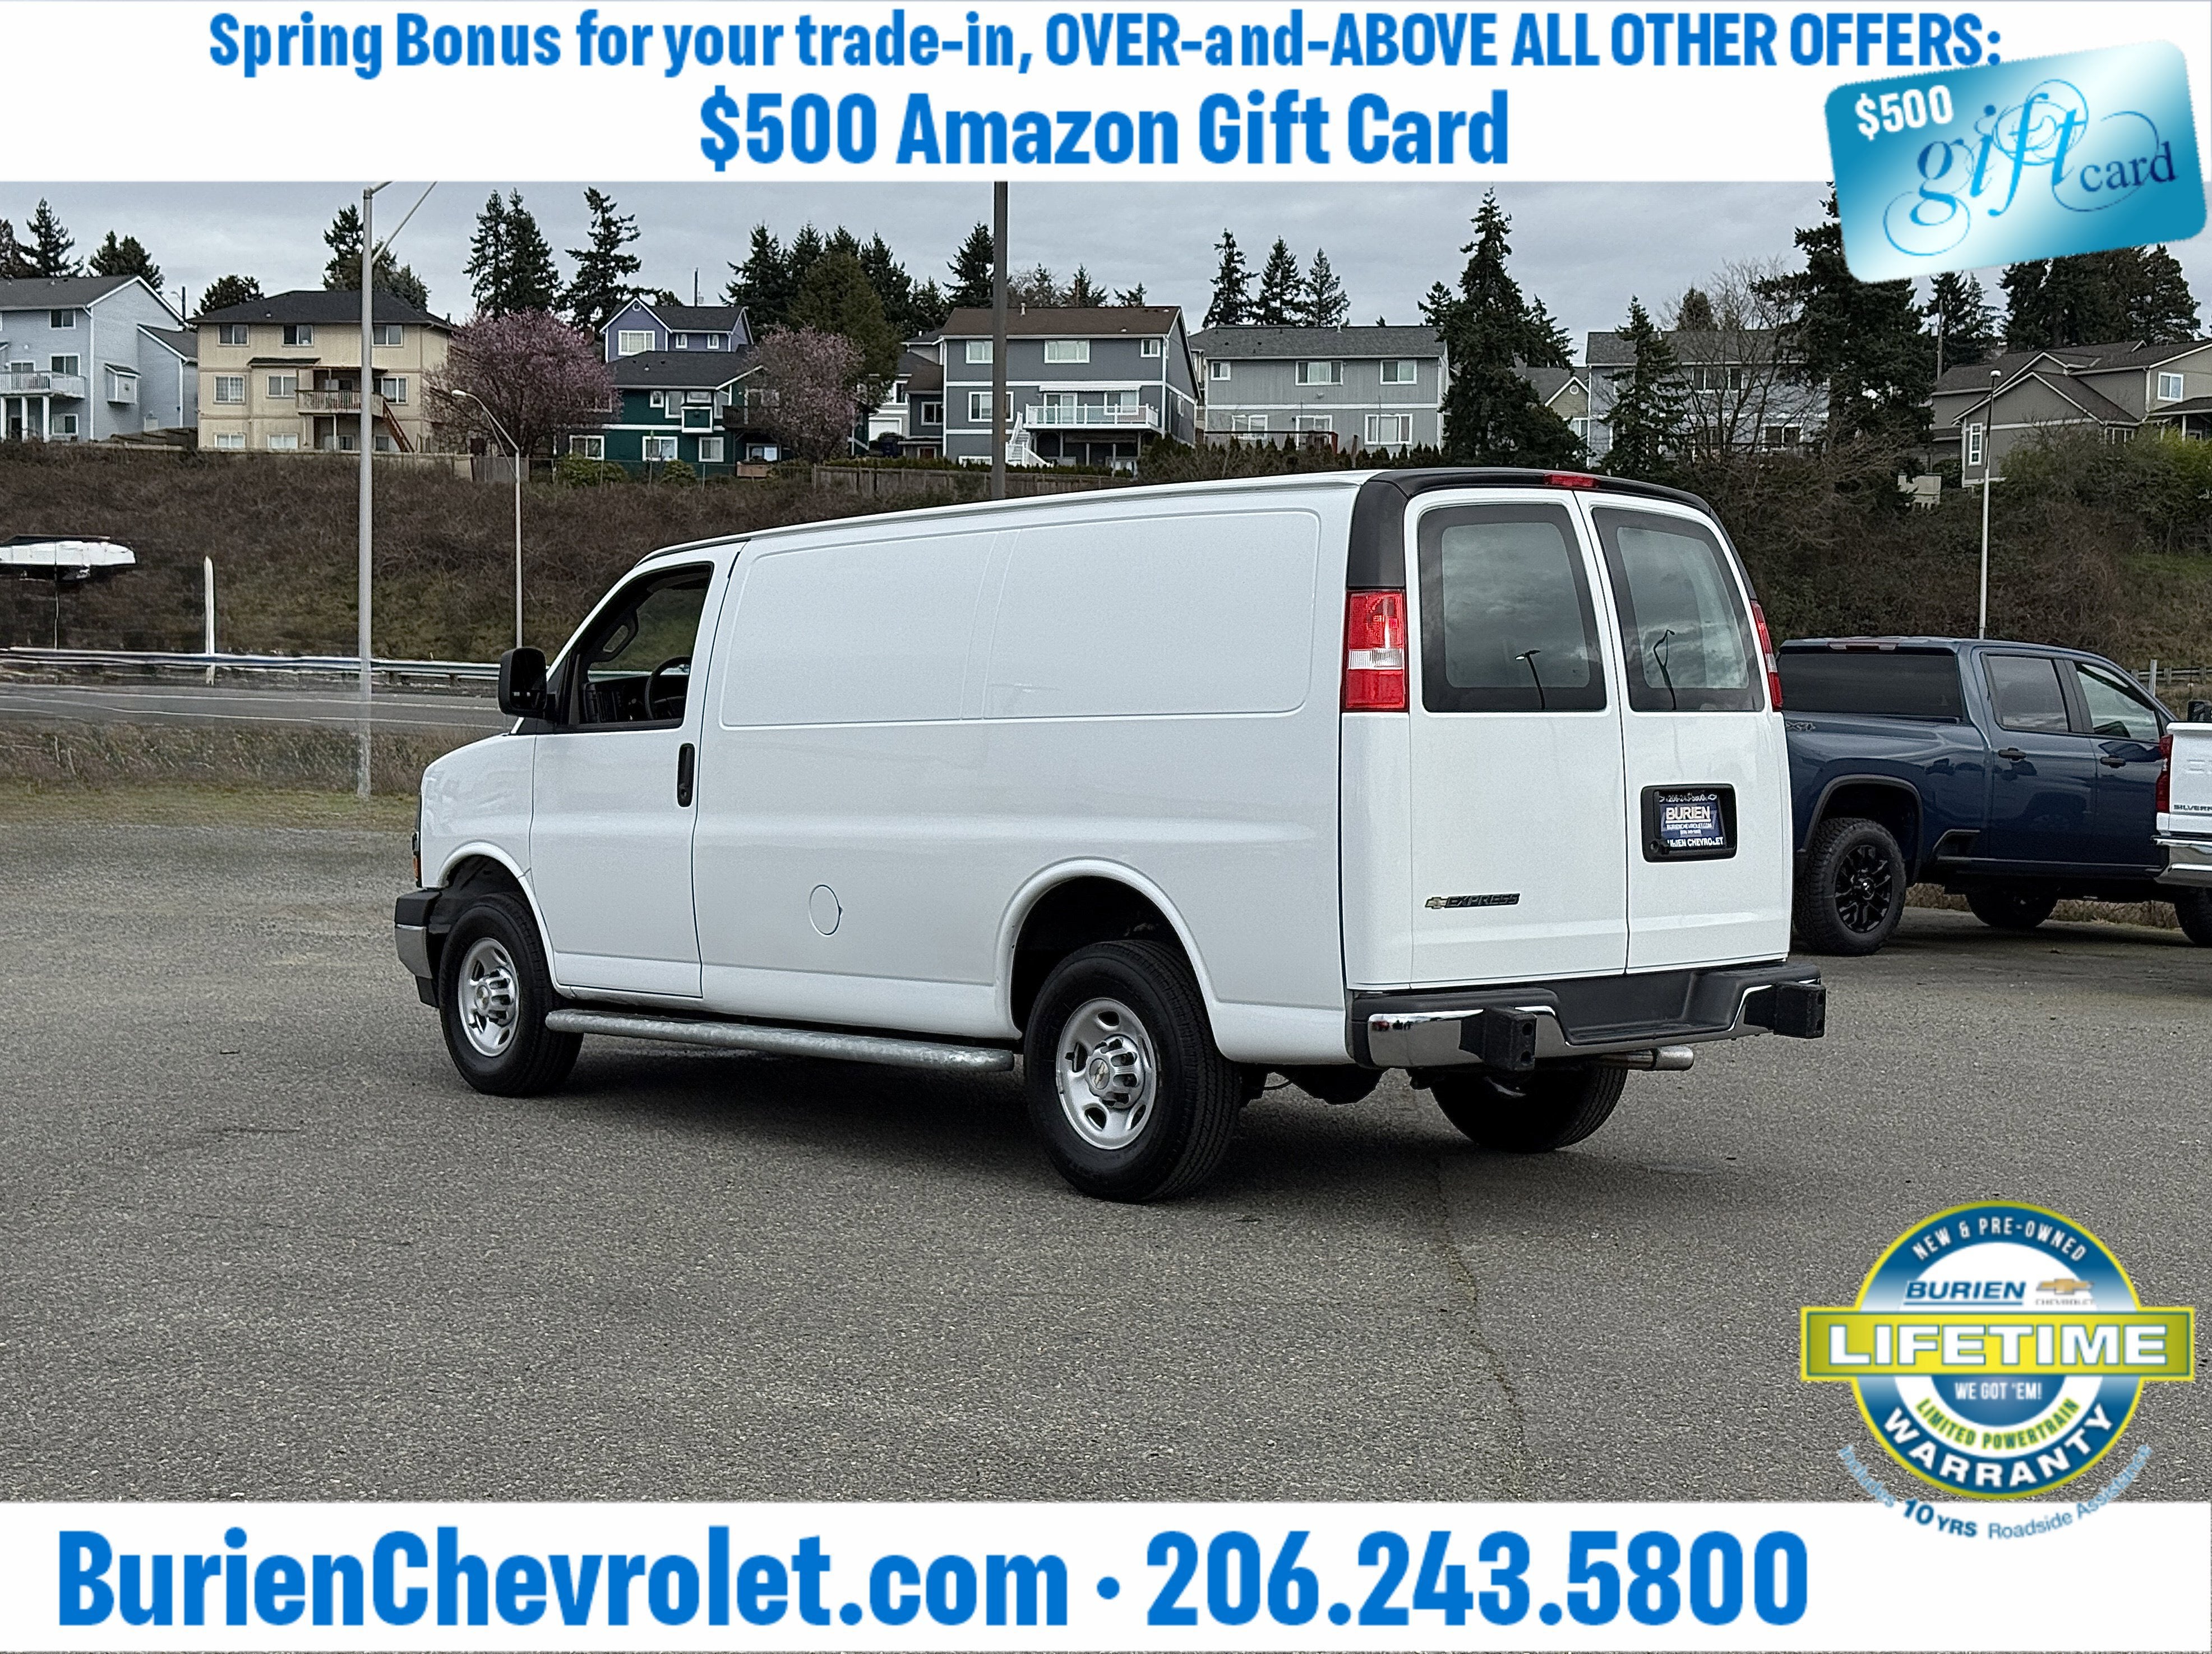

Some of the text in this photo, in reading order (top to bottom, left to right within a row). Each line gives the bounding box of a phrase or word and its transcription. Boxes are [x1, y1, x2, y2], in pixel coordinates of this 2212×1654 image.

[1666, 806, 1710, 820] BURIEN
[1687, 836, 1724, 847] CHEVROLET
[1446, 893, 1520, 907] EXPRESS
